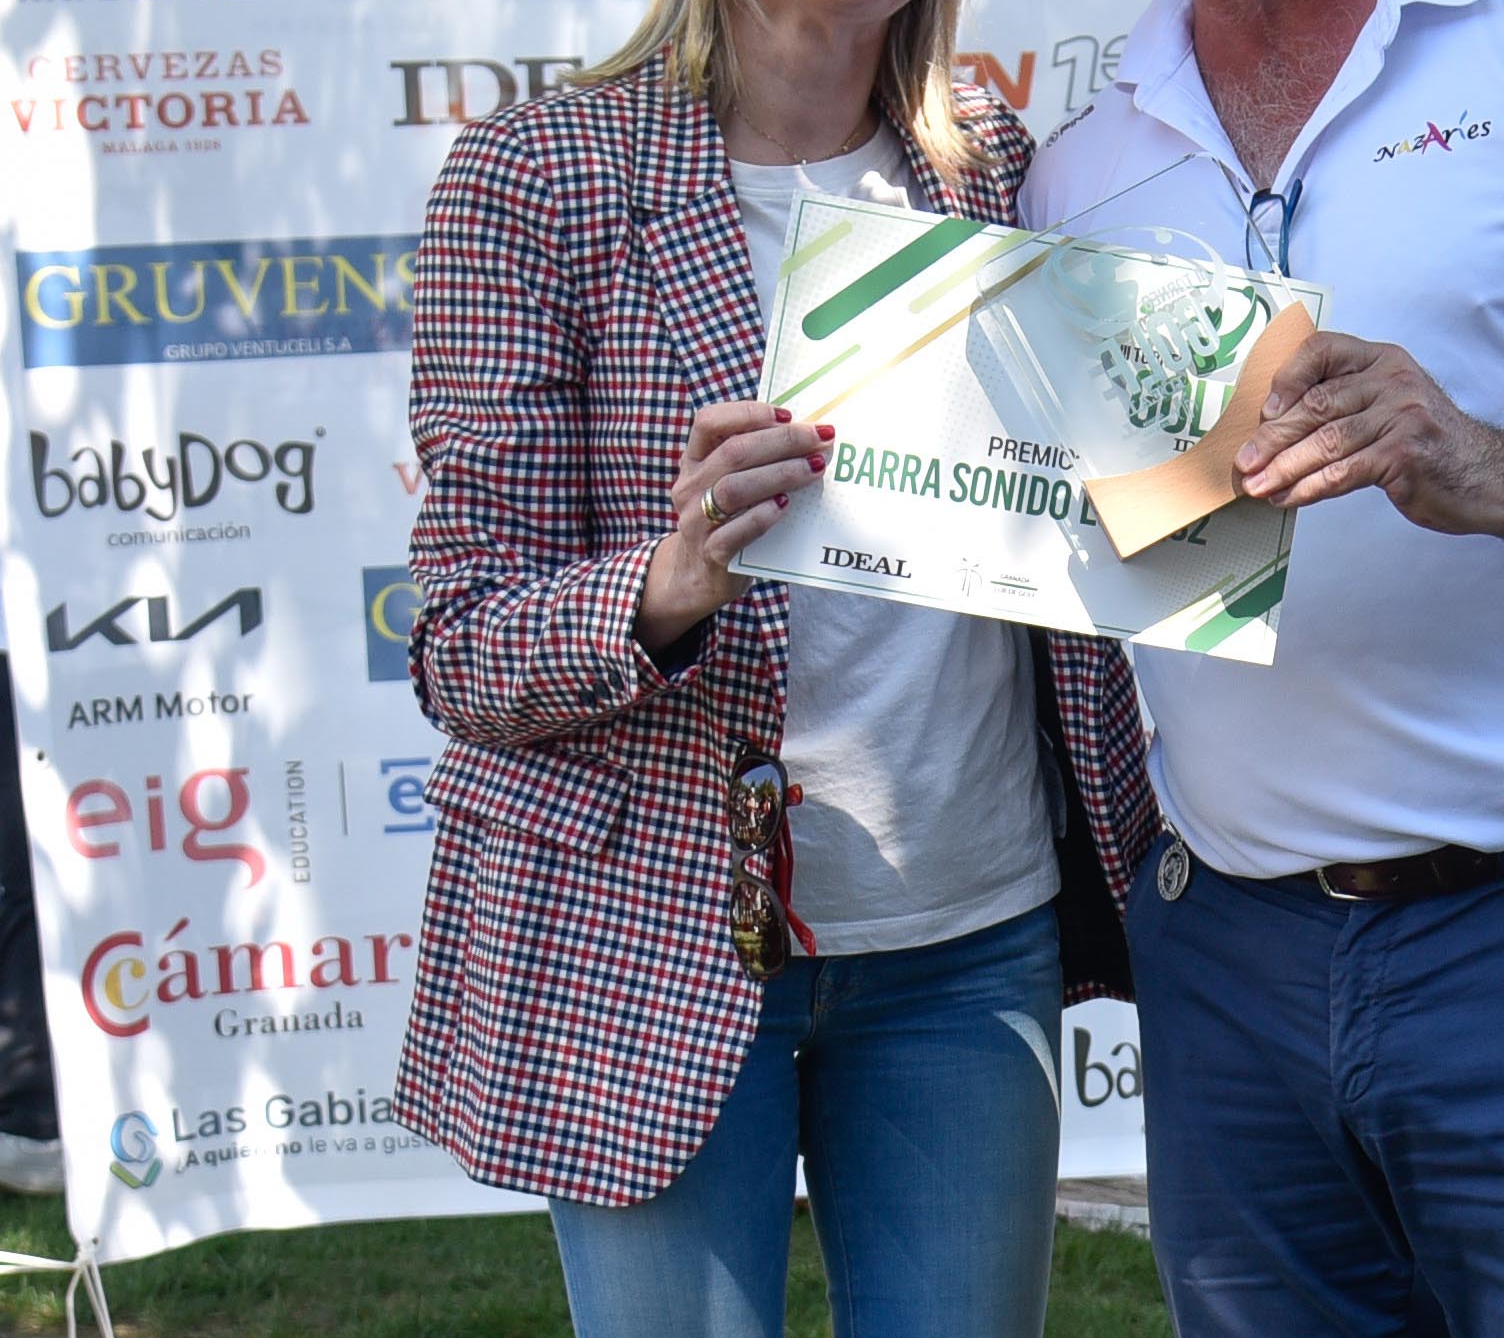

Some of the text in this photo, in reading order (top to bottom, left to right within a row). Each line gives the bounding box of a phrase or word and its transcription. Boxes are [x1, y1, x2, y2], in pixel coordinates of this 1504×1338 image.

[27, 49, 284, 83] CERVEZAS
[10, 88, 311, 134] VICTORIA
[1058, 103, 1096, 137] PING
[164, 342, 227, 361] GRUPO
[231, 339, 321, 358] VENTUCELI
[834, 442, 942, 499] BARRA
[949, 461, 1073, 521] SONIDO
[106, 522, 252, 549] comunicación
[819, 546, 913, 580] IDEAL
[66, 688, 254, 731] ARM Motor
[65, 768, 267, 890] eig
[285, 758, 312, 884] EDUCATION
[80, 918, 415, 1039] Cámar
[213, 1002, 366, 1041] Granada
[171, 1088, 395, 1143] Las Gabia
[276, 1140, 304, 1156] no
[309, 1136, 328, 1154] le
[334, 1137, 358, 1153] va
[364, 1137, 377, 1152] a
